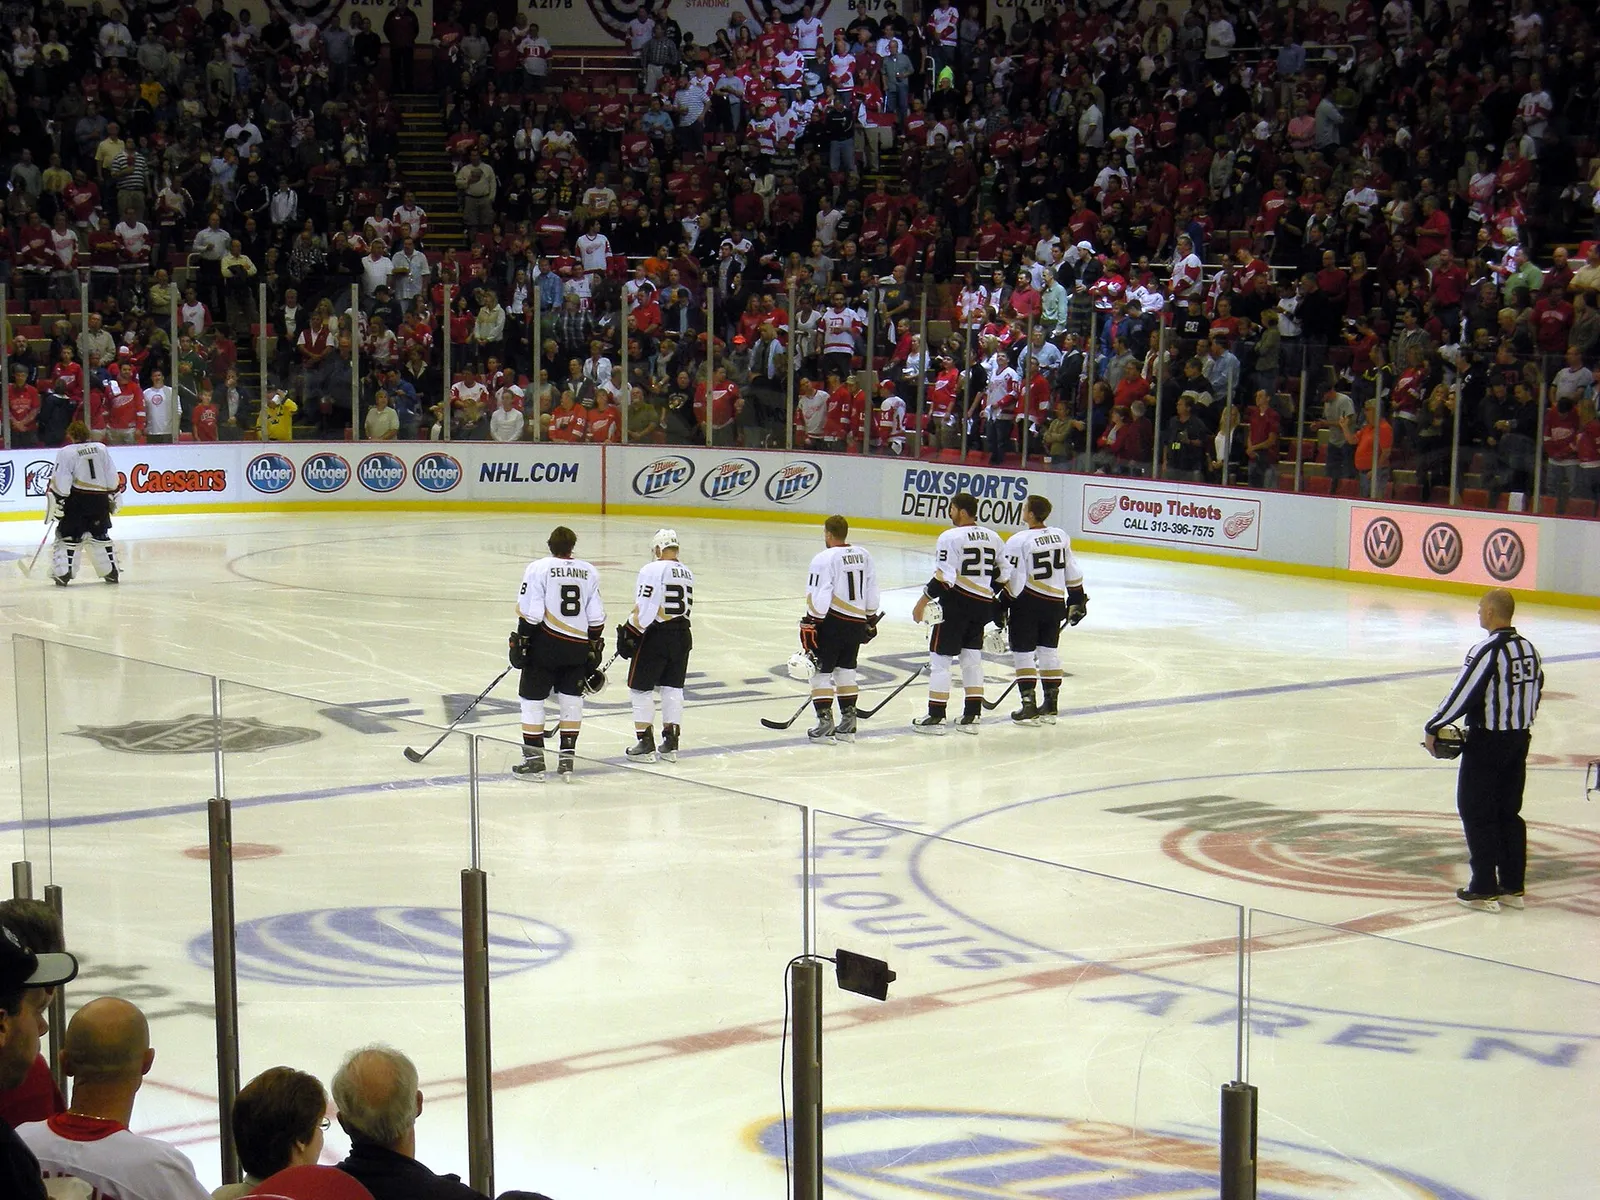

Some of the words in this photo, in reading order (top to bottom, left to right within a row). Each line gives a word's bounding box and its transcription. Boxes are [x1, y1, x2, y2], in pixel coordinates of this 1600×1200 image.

[87, 458, 96, 480] 1
[130, 463, 227, 493] Caesars
[252, 458, 292, 489] Kroger
[308, 458, 348, 489] Kroger
[363, 458, 403, 489] Kroger
[419, 458, 459, 489] Kroger
[479, 462, 579, 483] NHL.COM
[643, 467, 687, 497] Lite
[651, 460, 678, 474] Miller
[717, 463, 744, 476] Miller
[781, 465, 807, 479] Miller
[711, 469, 752, 499] Lite
[775, 472, 815, 502] Lite
[901, 493, 1023, 526] DETR.COM
[1119, 495, 1162, 518] Group
[1166, 500, 1222, 521] Tickets
[1123, 517, 1149, 531] CALL
[1150, 520, 1215, 538] 313-396-7575
[1367, 520, 1401, 564] VW
[842, 553, 864, 566] KOIVU
[961, 548, 995, 576] 23
[1426, 527, 1460, 571] VW
[1487, 533, 1522, 578] VW
[550, 567, 589, 581] SELANNE
[1032, 549, 1066, 580] 54
[844, 569, 864, 601] 11
[560, 584, 581, 617] 8
[1512, 657, 1536, 684] 93
